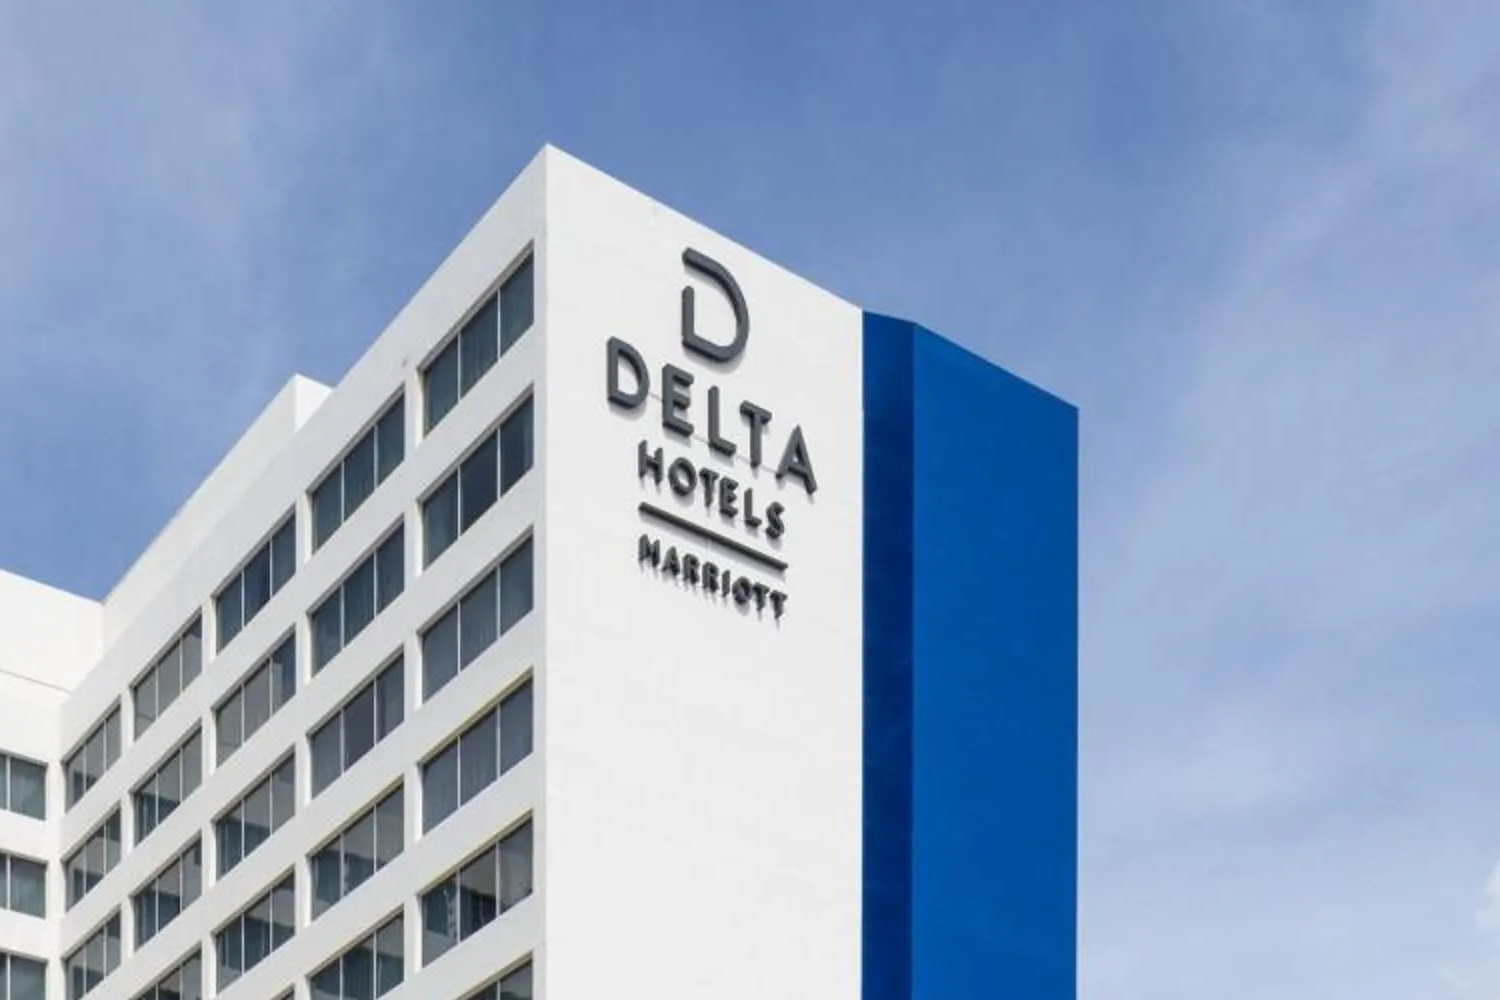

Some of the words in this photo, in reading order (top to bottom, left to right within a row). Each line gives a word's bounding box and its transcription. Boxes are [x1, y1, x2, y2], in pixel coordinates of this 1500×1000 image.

[681, 247, 750, 364] D
[606, 336, 818, 496] DELTA
[637, 439, 786, 541] HOTELS
[637, 533, 789, 620] MARRIOTT
